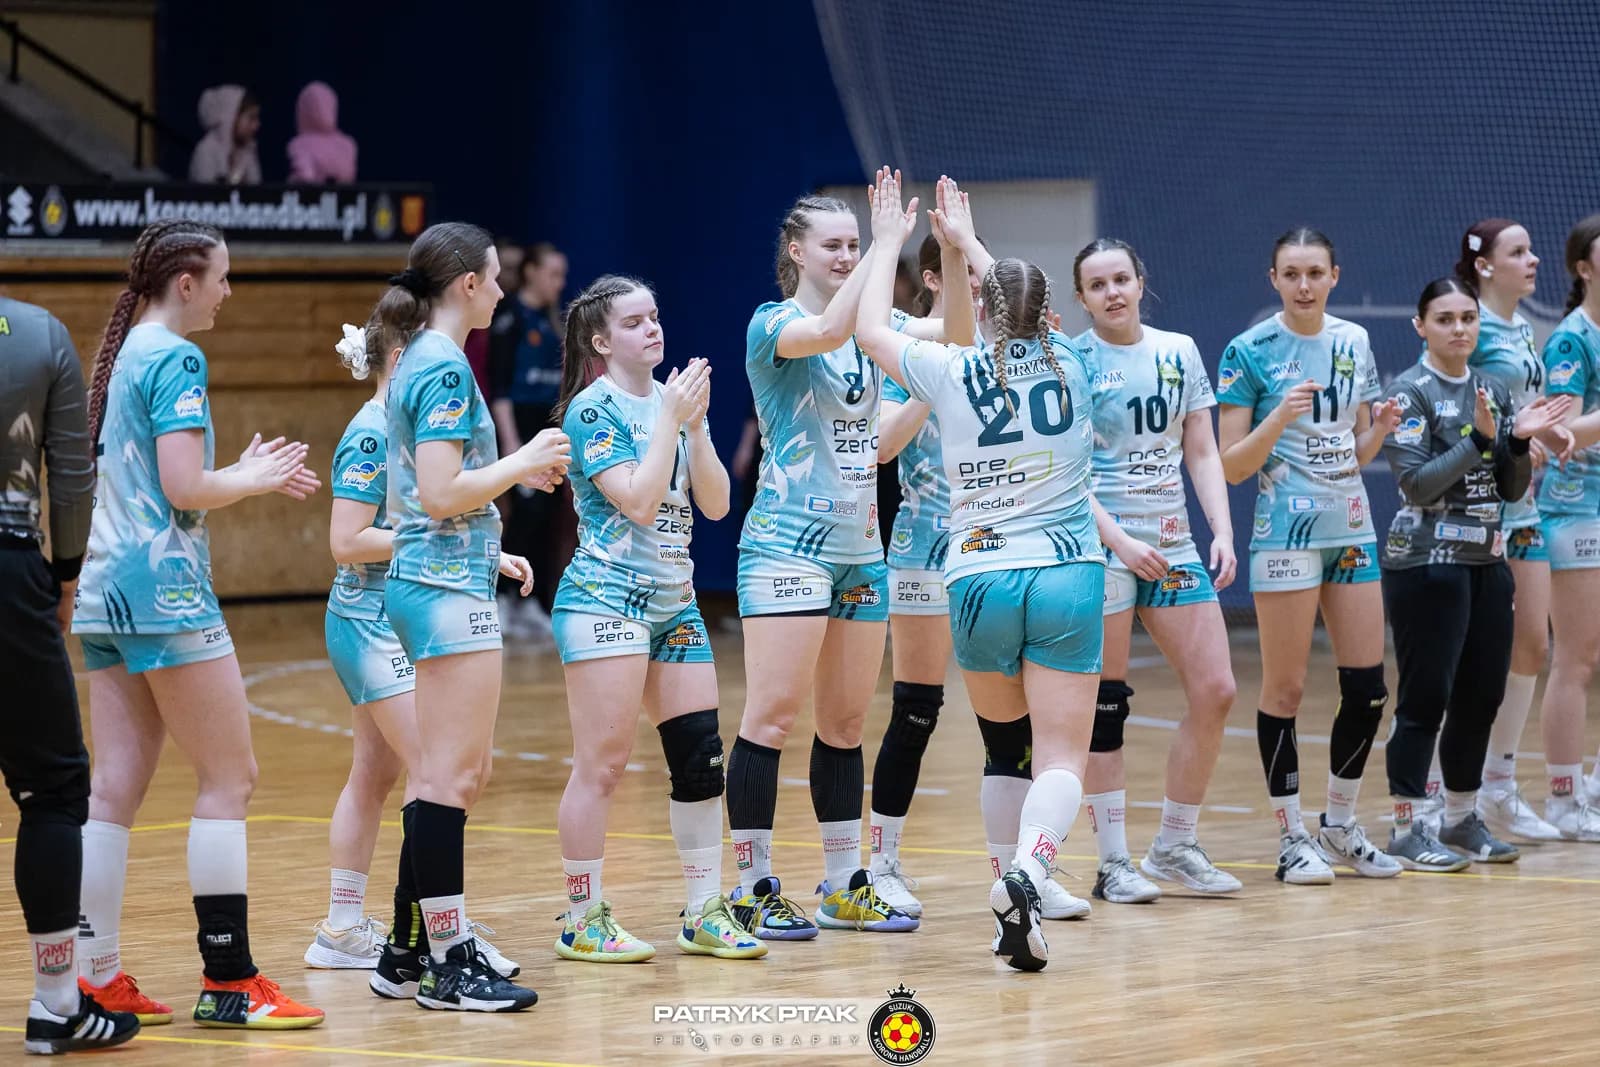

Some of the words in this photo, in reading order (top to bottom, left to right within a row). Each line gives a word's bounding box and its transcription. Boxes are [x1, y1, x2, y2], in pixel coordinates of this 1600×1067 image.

[74, 188, 366, 240] www.koronahandball.pl
[1524, 359, 1542, 392] 14
[843, 372, 865, 404] 8
[1313, 385, 1339, 423] 11
[977, 380, 1074, 447] 20
[1127, 395, 1168, 435] 10
[833, 418, 867, 436] pre
[1306, 435, 1341, 452] pre
[1307, 448, 1353, 464] zero
[959, 458, 1007, 477] pre
[962, 472, 1026, 490] zero
[1576, 548, 1600, 557] zer
[1267, 558, 1290, 570] pre
[1268, 567, 1300, 578] zero
[773, 576, 800, 590] pre
[898, 581, 920, 592] pre
[774, 585, 812, 598] zero
[898, 589, 930, 602] zero
[469, 611, 492, 624] pre
[594, 620, 622, 633] pre
[596, 631, 634, 643] zero
[395, 666, 415, 678] ze
